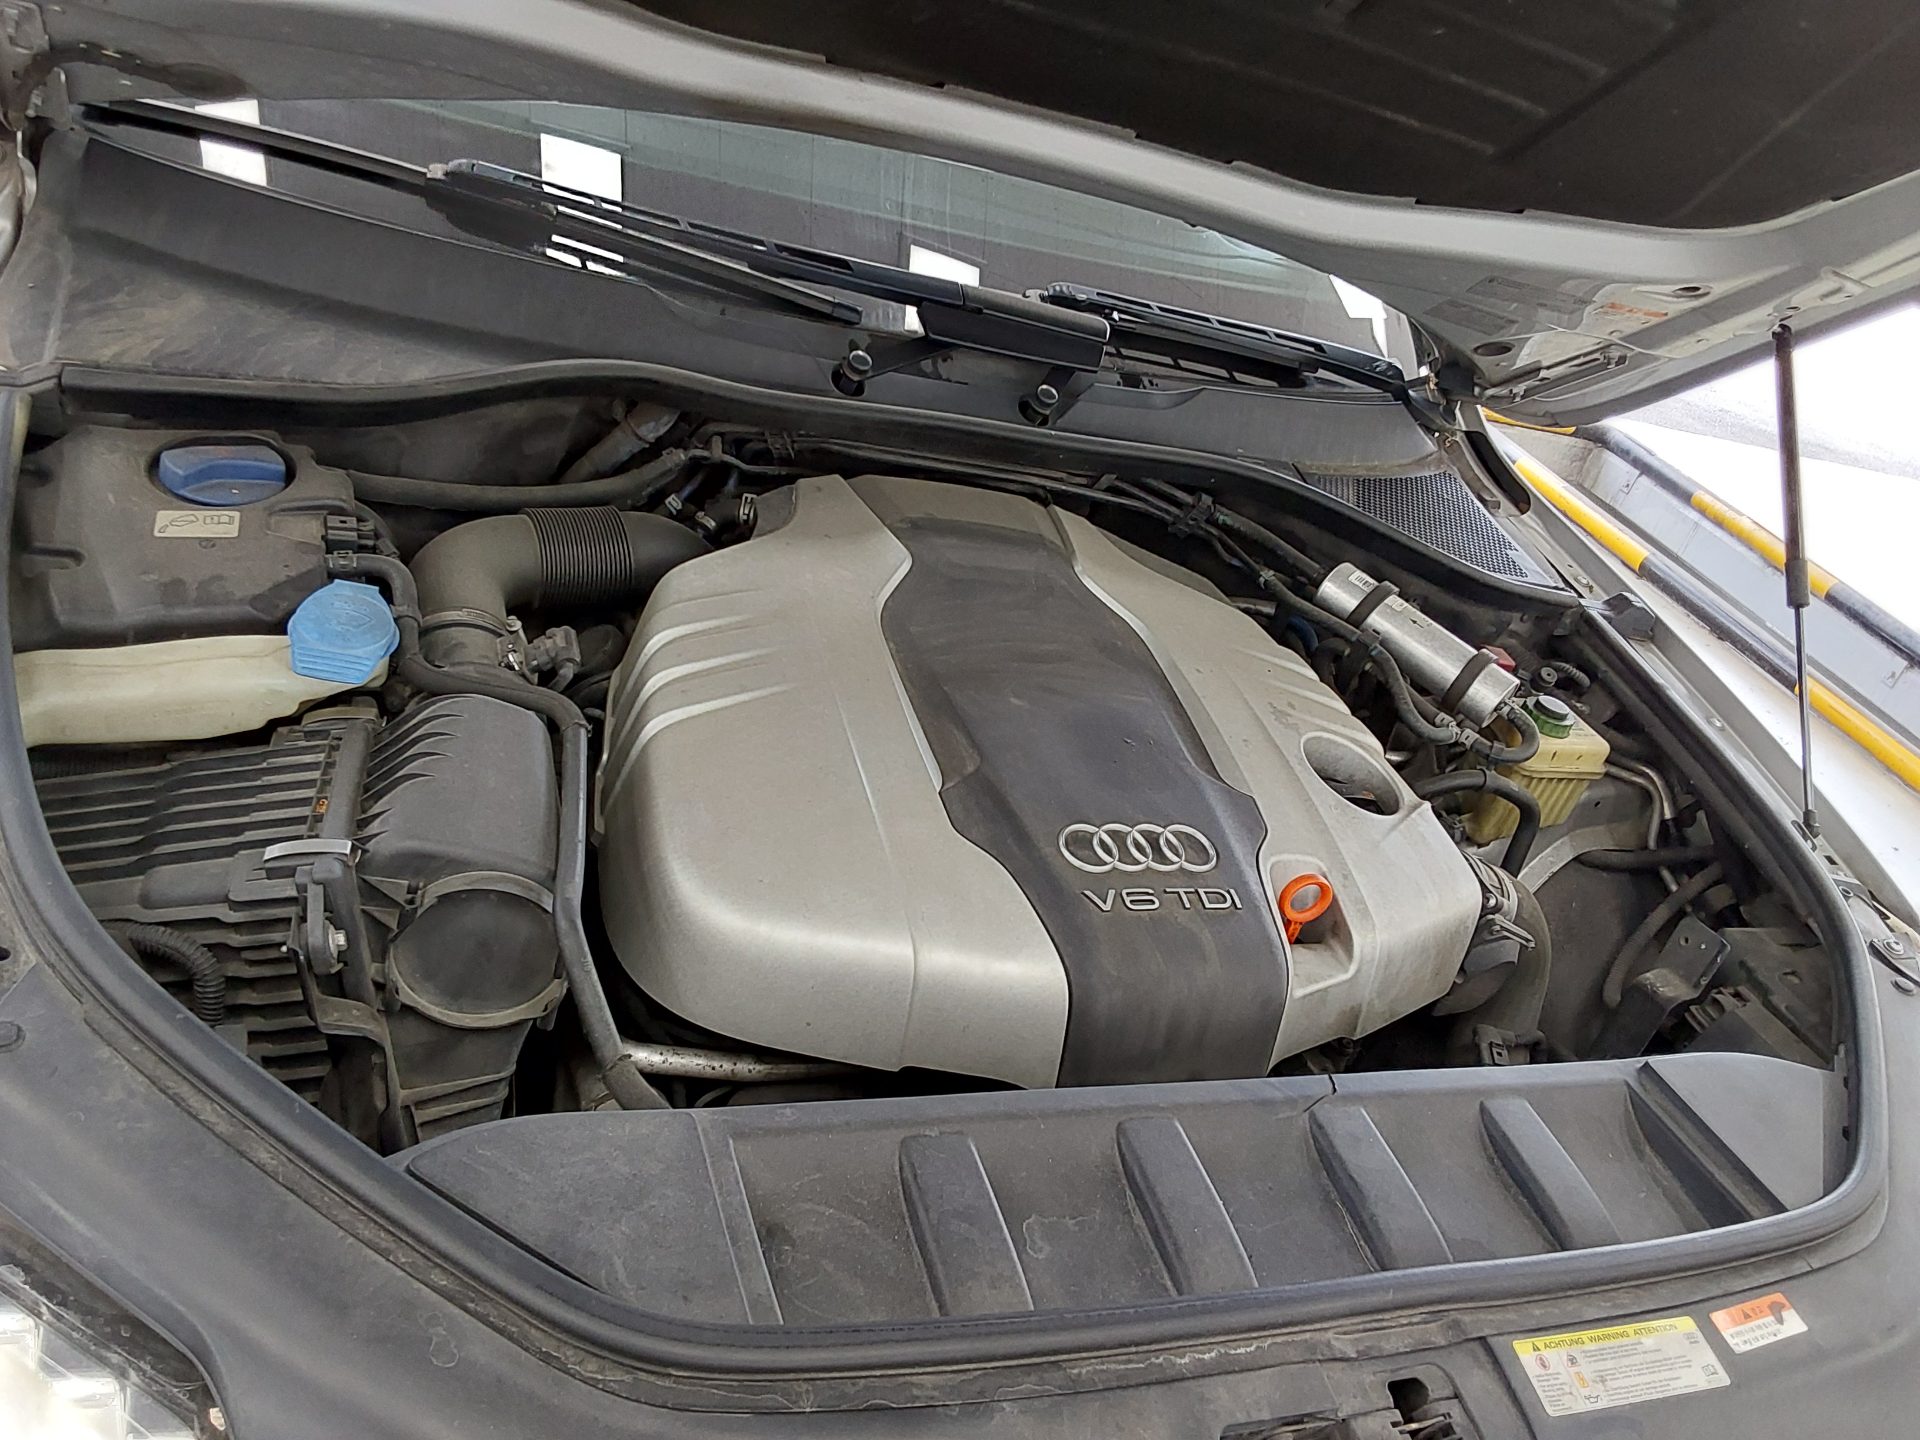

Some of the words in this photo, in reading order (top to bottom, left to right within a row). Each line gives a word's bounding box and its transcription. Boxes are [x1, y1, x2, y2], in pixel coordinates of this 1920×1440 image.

[1082, 888, 1160, 912] V6
[1164, 887, 1243, 911] TDI
[1544, 1337, 1586, 1350] ACHTUNG
[1587, 1330, 1630, 1343] WARNING
[1633, 1323, 1678, 1337] ATTENTION
